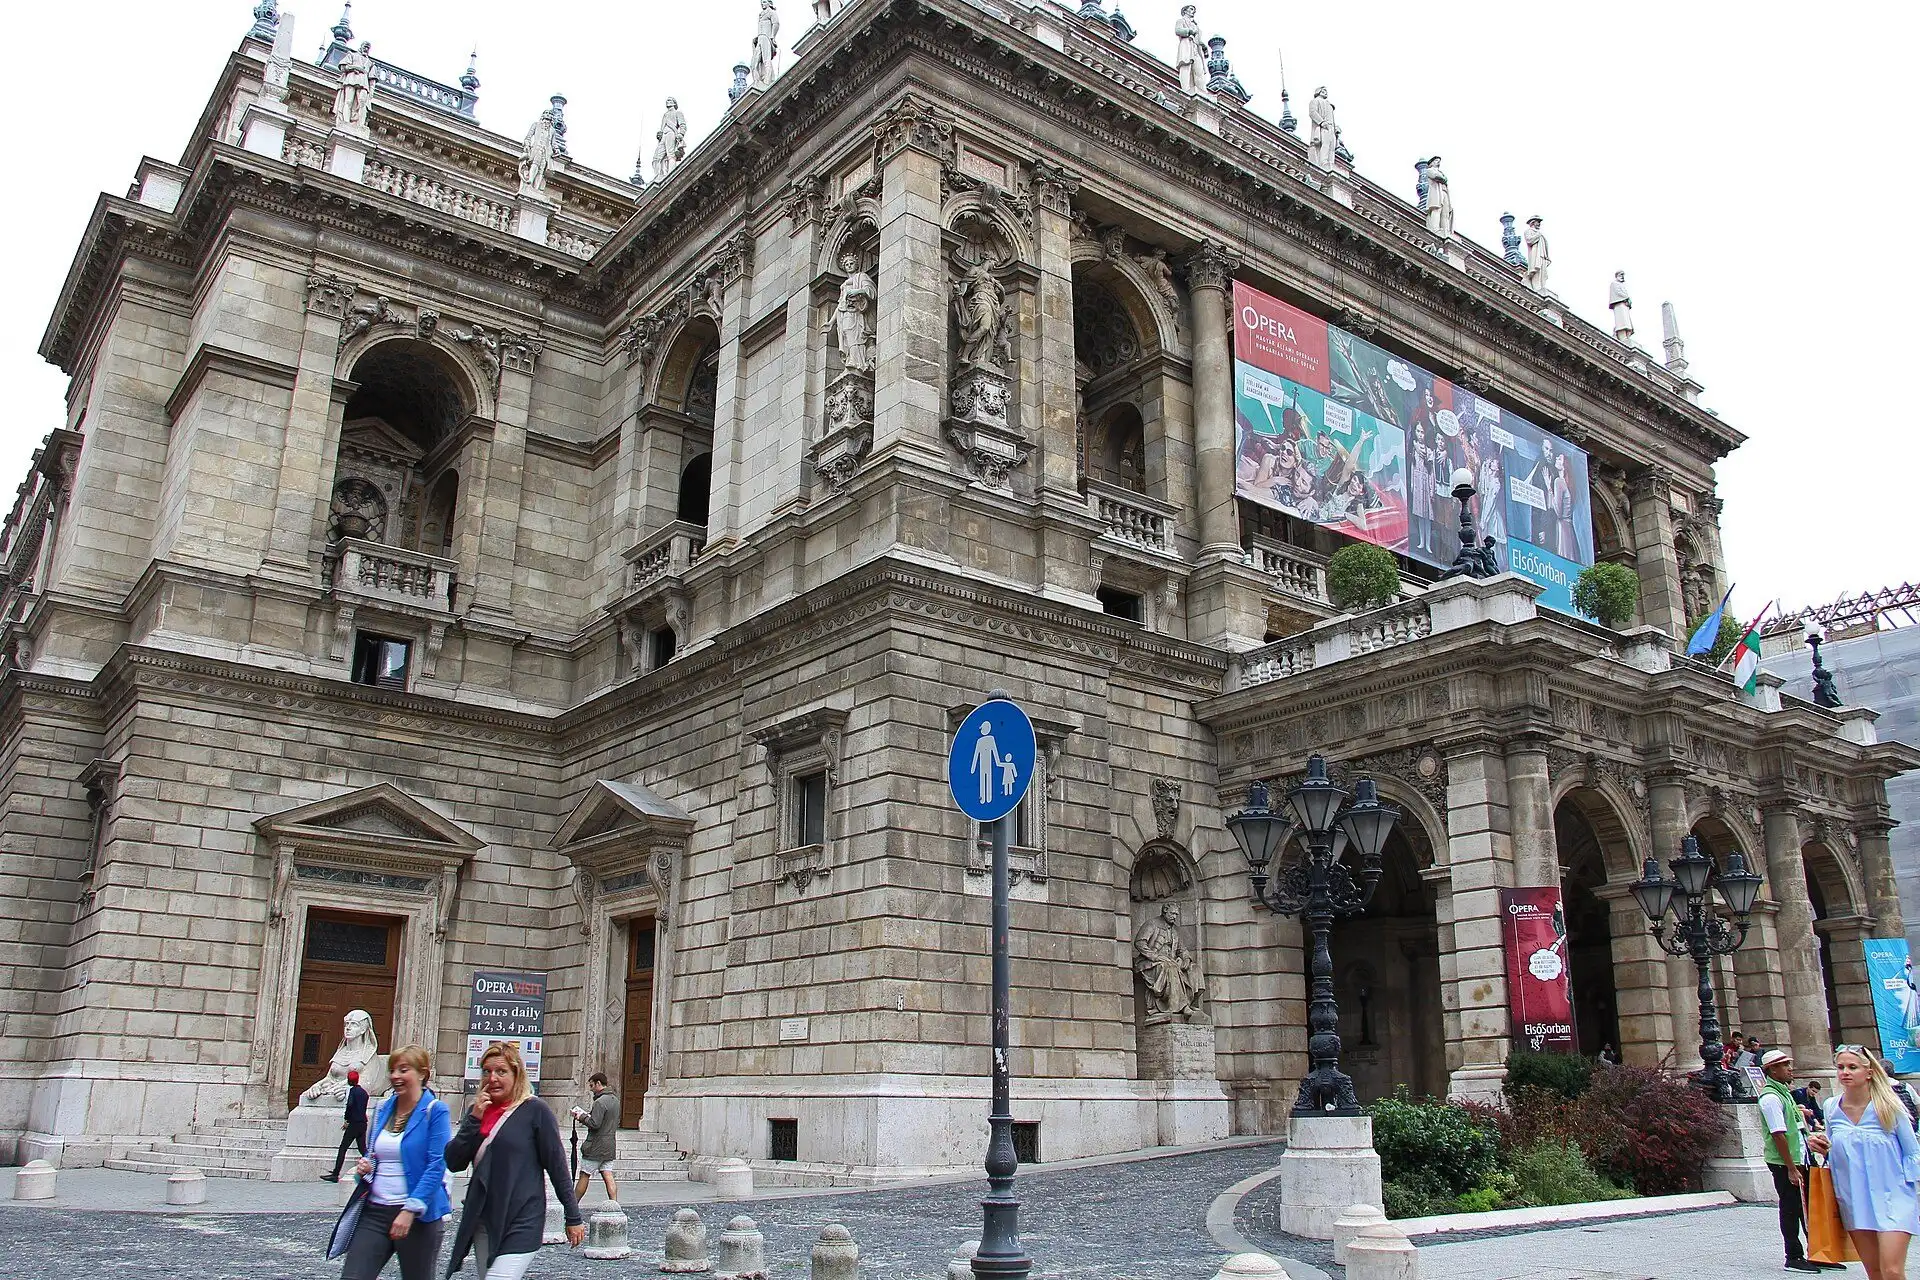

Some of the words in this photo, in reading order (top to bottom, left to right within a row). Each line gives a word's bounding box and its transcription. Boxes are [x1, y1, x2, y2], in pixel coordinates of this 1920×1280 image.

[1242, 305, 1298, 345] OPERA
[1255, 334, 1275, 346] MAGYAR
[1255, 342, 1284, 358] HUNGARIAN
[1512, 548, 1567, 588] ElsőSorban
[1508, 904, 1539, 915] OPERA
[1870, 951, 1894, 960] OPERA
[474, 1004, 508, 1017] Tours
[511, 1006, 541, 1020] daily
[471, 1021, 482, 1030] at
[484, 1020, 494, 1032] 2,
[496, 1021, 506, 1032] 3,
[508, 1021, 515, 1031] 4
[518, 1023, 541, 1034] p.m.
[1524, 1023, 1571, 1035] ElsőSorban
